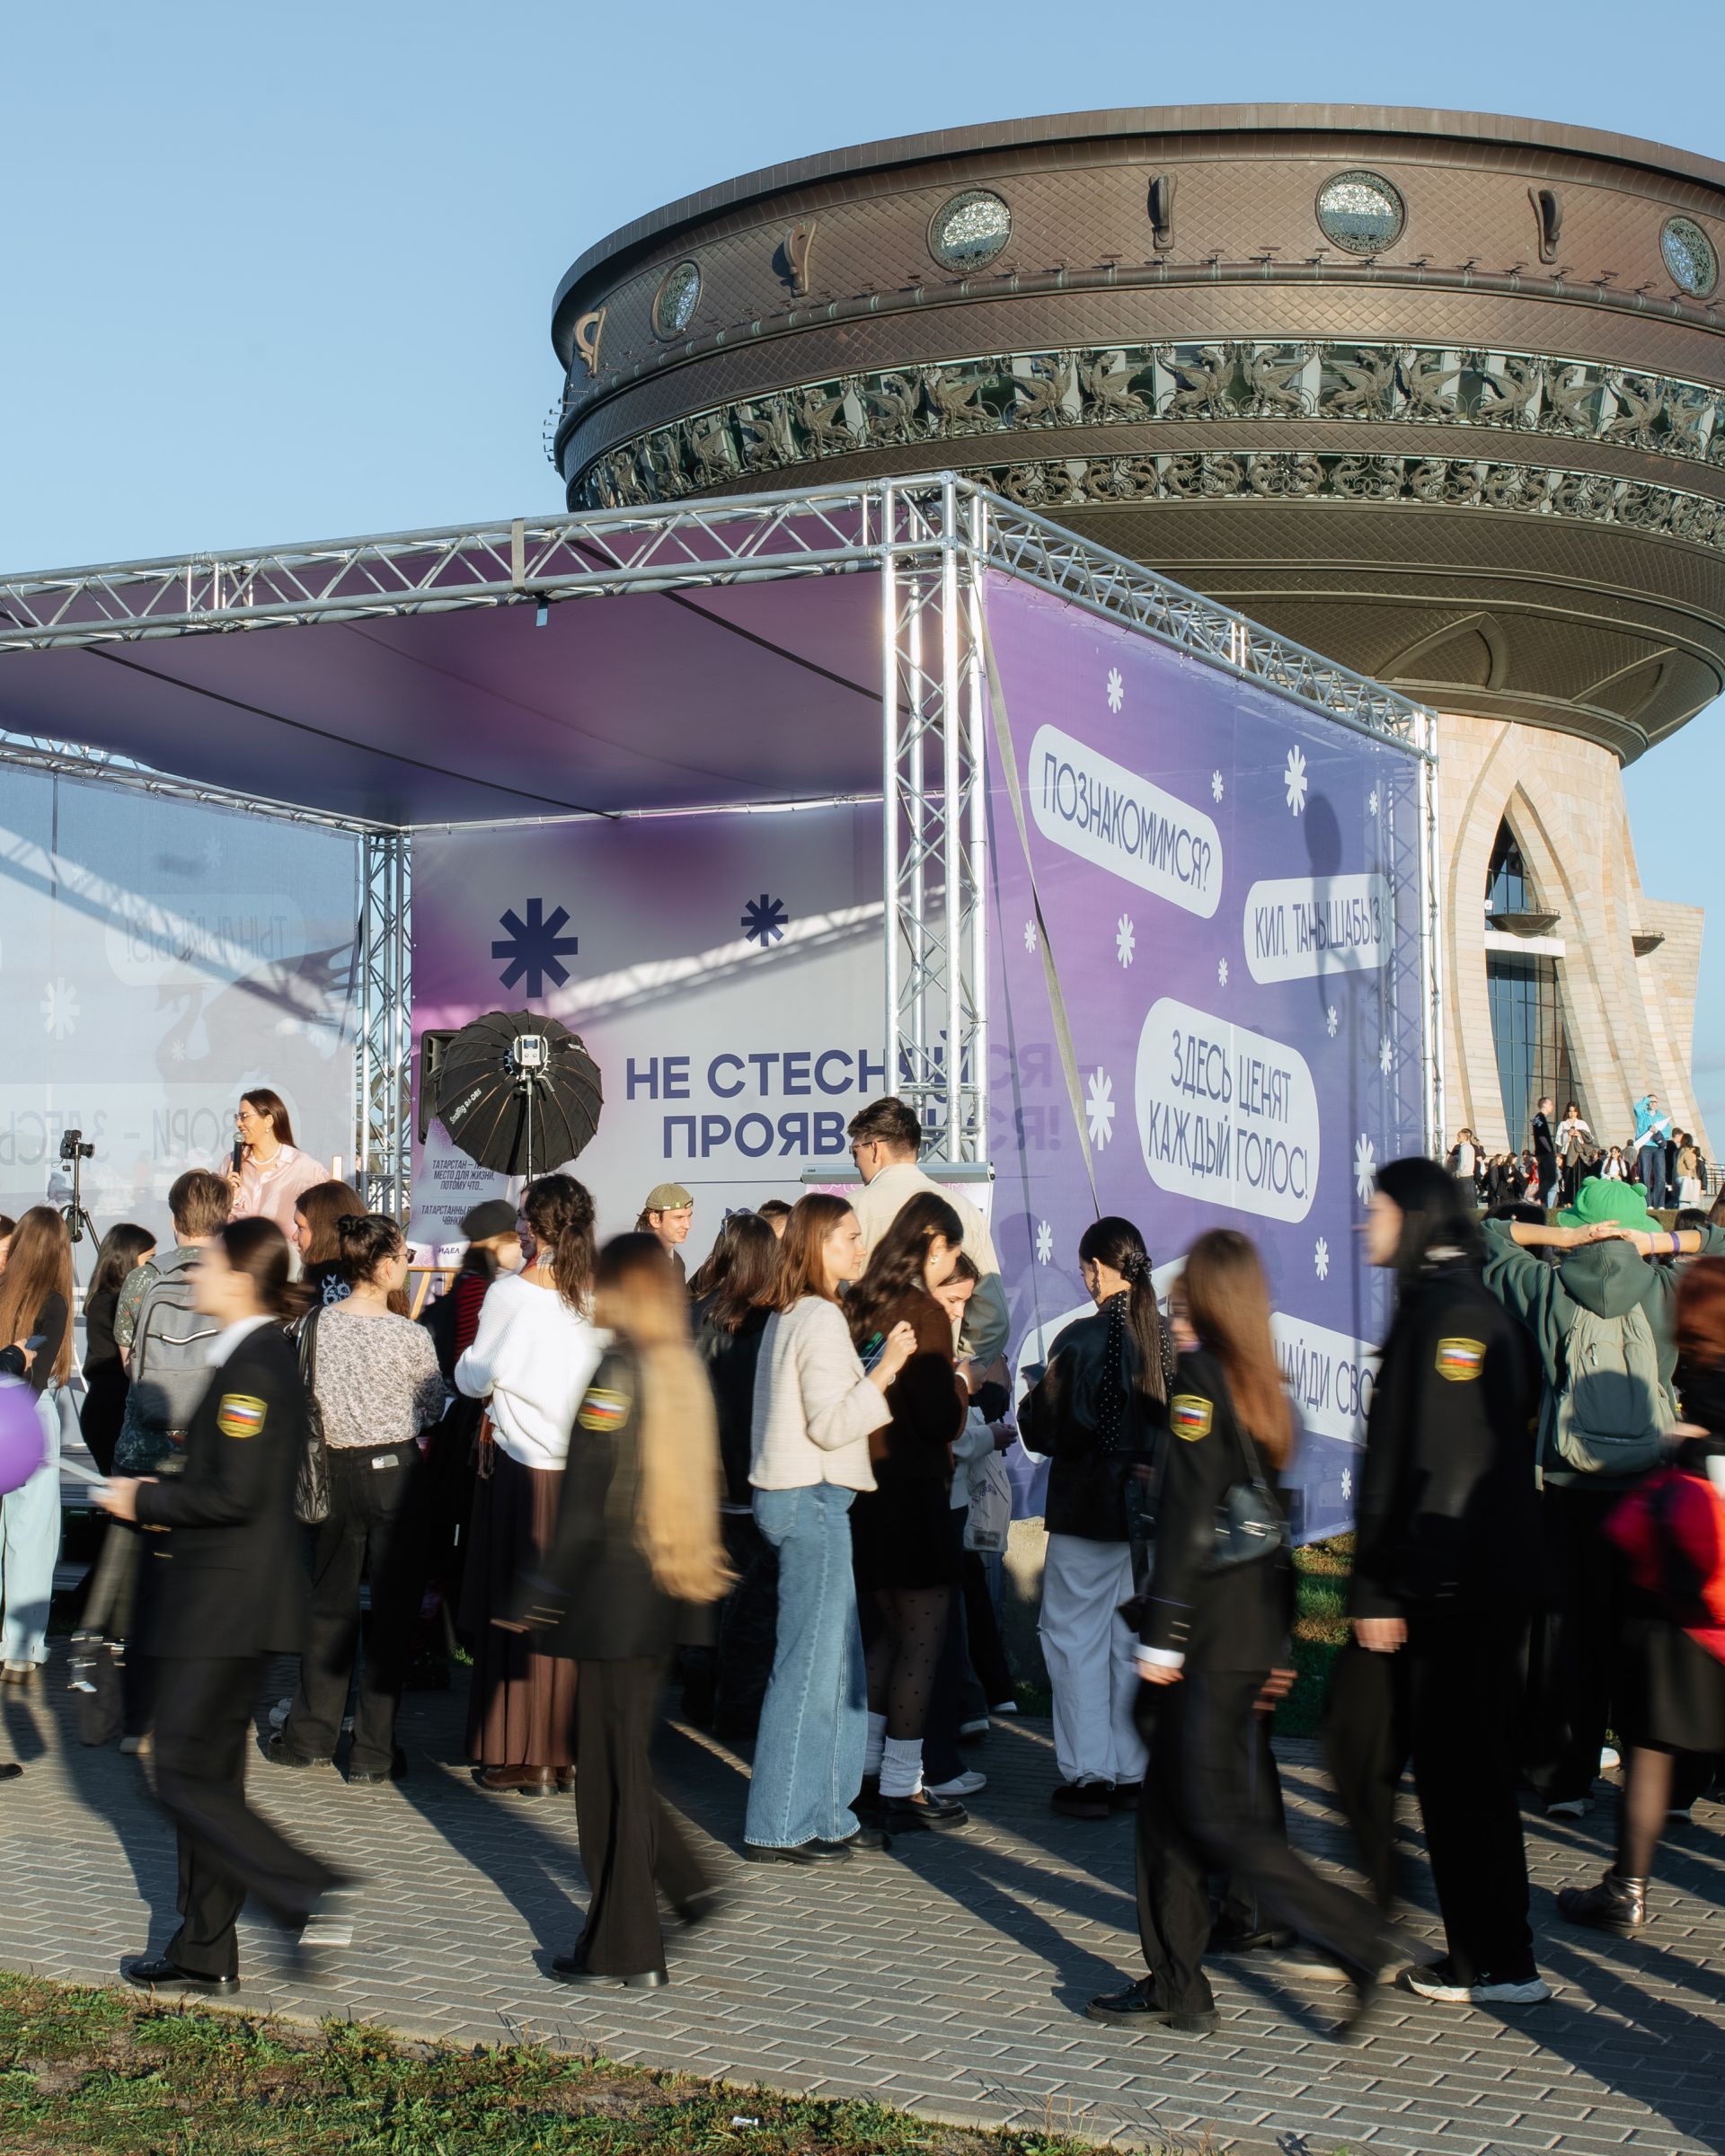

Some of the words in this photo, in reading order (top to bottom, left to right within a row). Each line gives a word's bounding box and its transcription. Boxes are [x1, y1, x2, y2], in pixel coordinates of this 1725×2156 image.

[1043, 752, 1211, 892] ПОЗНАКОМИМСЯ?
[1255, 905, 1287, 959] КИЛ,
[626, 1056, 690, 1100] НЕ
[1171, 1029, 1232, 1104] ЗДЕСЬ
[1239, 1055, 1291, 1124] ЦЕНЯТ
[432, 1160, 467, 1170] ТАТАРСТАН
[1148, 1100, 1231, 1179] КАЖДЫЙ
[1236, 1127, 1308, 1200] ГОЛОС!
[433, 1171, 454, 1180] МЕСТО
[455, 1171, 470, 1180] ДЛЯ
[440, 1180, 466, 1190] ПОТОМУ
[421, 1205, 467, 1215] ТАТАРСТАННЫ
[438, 1247, 460, 1255] ИДЕЛ
[1336, 1360, 1378, 1421] СВО
